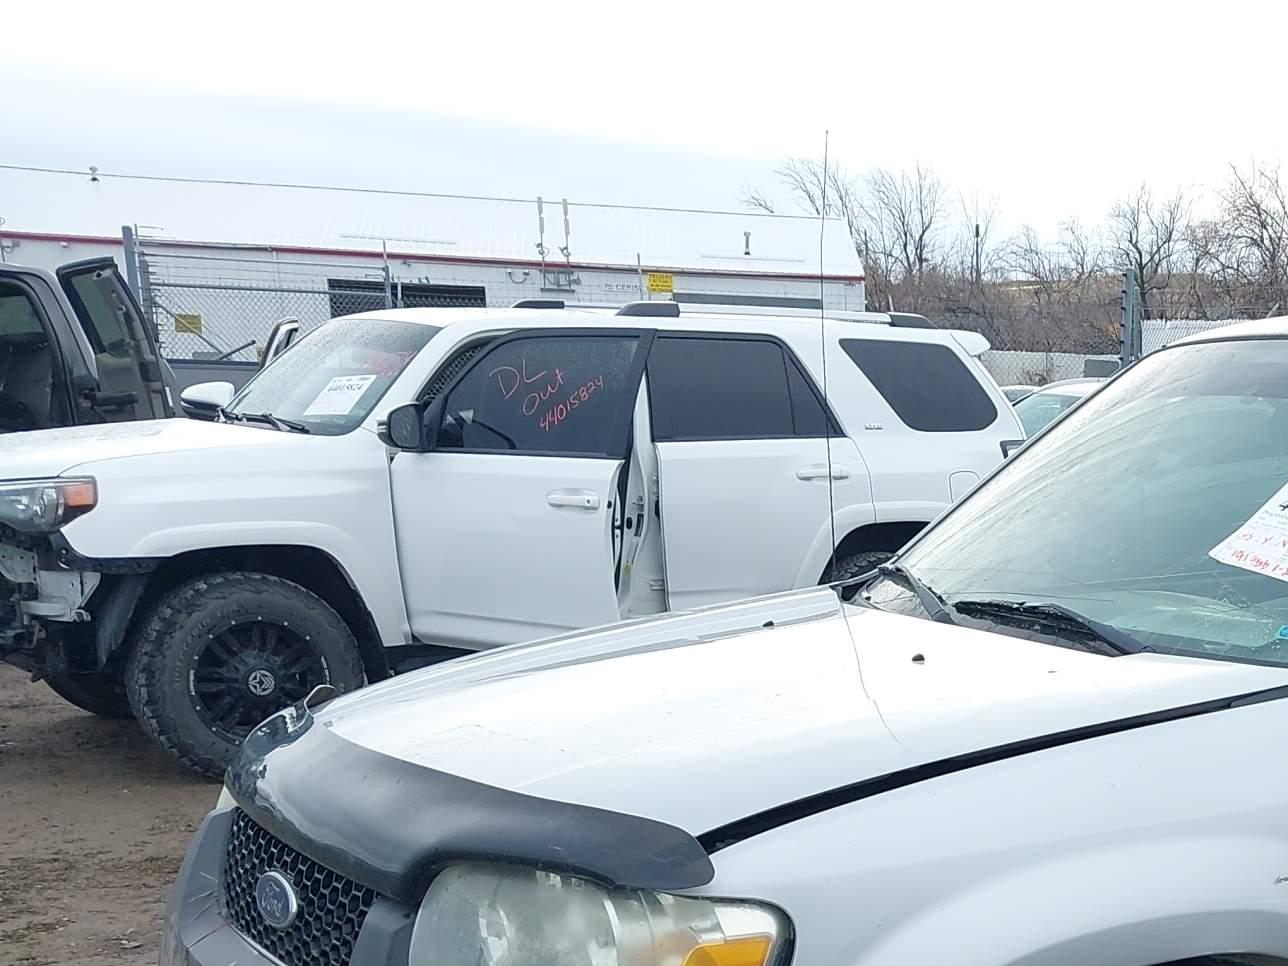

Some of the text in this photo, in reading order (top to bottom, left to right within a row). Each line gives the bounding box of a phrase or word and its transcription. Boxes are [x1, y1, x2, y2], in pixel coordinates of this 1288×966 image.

[488, 357, 548, 400] DL
[539, 375, 604, 432] 44015824
[261, 881, 285, 918] Ford
